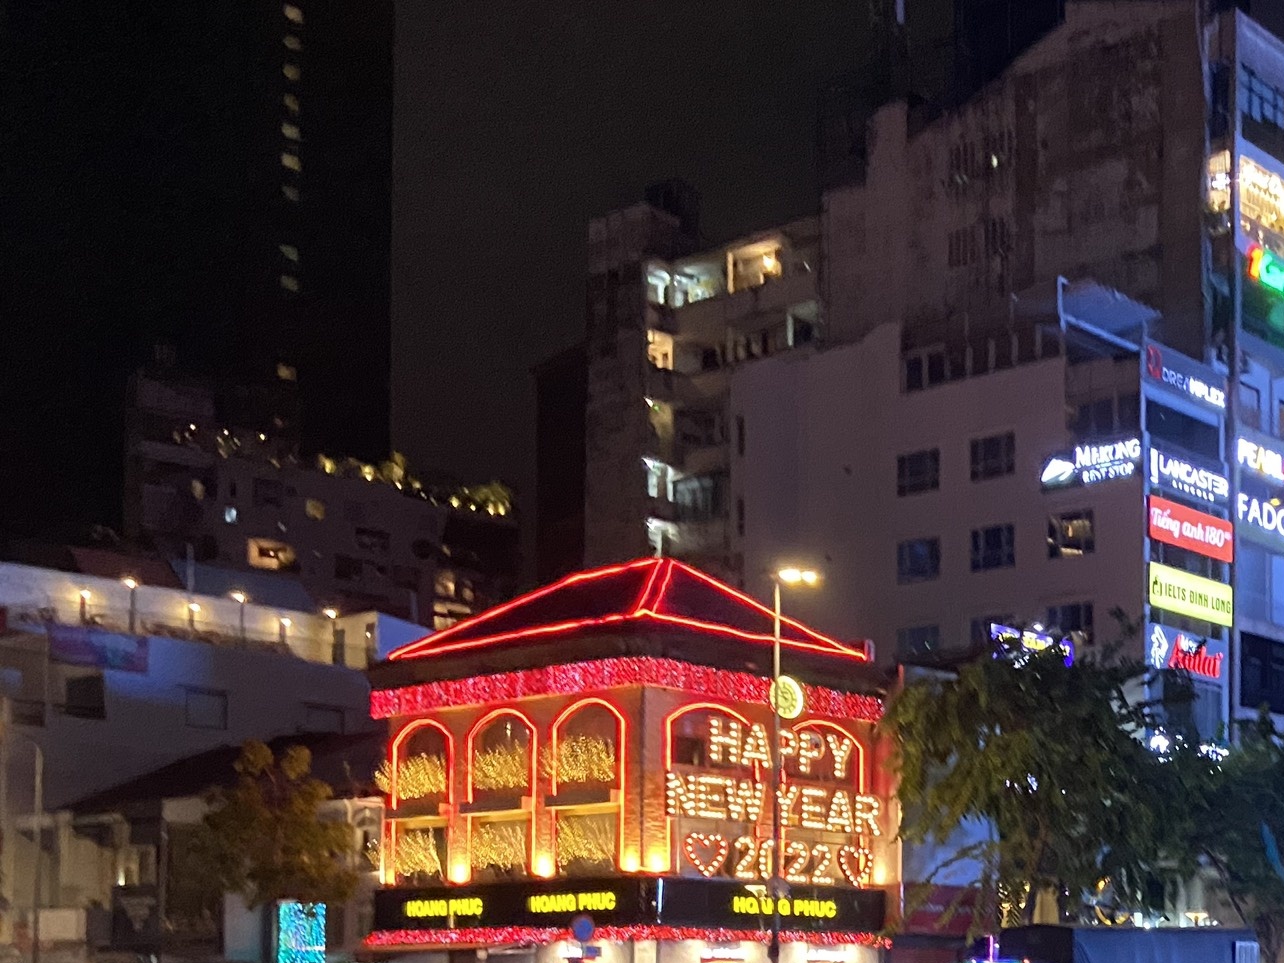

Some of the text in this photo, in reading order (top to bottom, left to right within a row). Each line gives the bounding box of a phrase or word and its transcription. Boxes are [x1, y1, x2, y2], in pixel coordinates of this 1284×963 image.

[1159, 453, 1229, 498] LANCASTER
[1164, 582, 1187, 602] IELTS
[1211, 596, 1232, 615] LONG
[709, 716, 853, 779] HAPPY
[666, 771, 884, 837] NEW YEAR
[734, 835, 835, 886] 2022
[793, 899, 837, 919] PHUC
